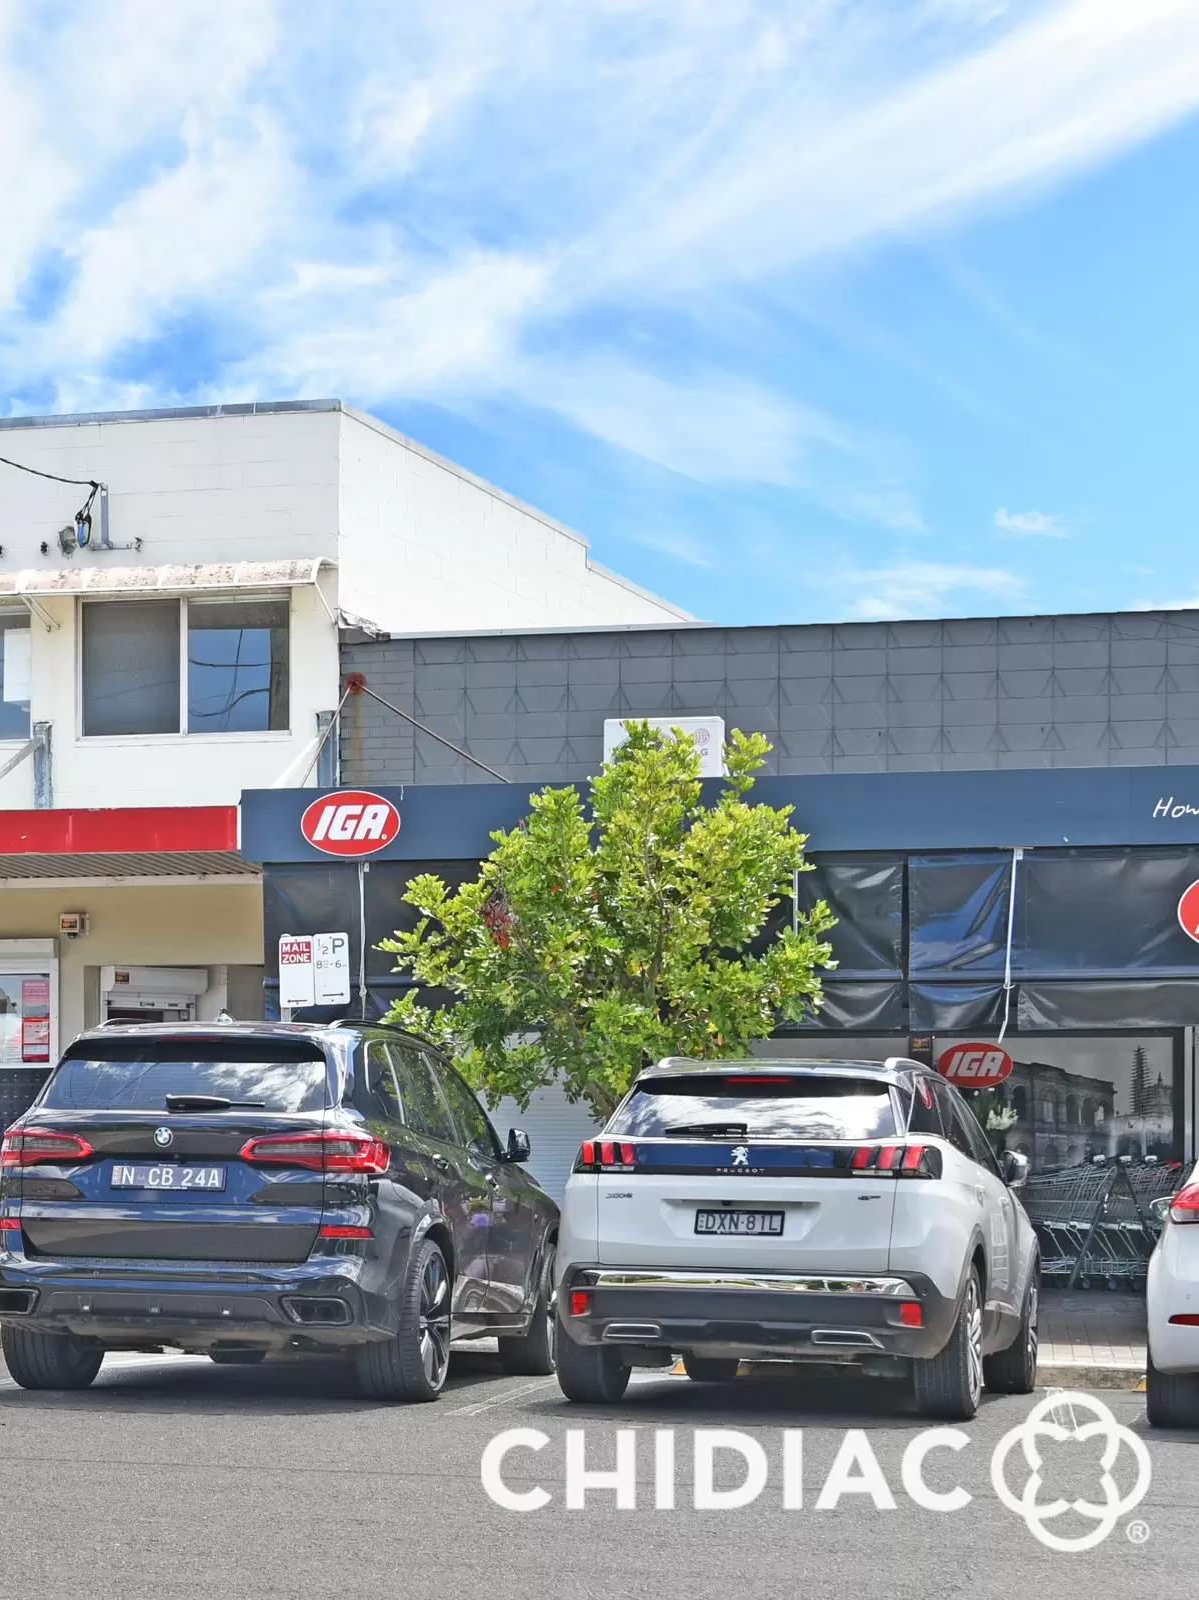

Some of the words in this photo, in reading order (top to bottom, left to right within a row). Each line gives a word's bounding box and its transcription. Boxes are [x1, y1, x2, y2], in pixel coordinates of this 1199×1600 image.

[311, 804, 390, 841] IGA
[282, 942, 310, 953] MAIL
[282, 953, 310, 964] ZONE
[944, 1051, 1006, 1077] IGA
[148, 1168, 174, 1186] CB
[181, 1169, 220, 1187] 24A
